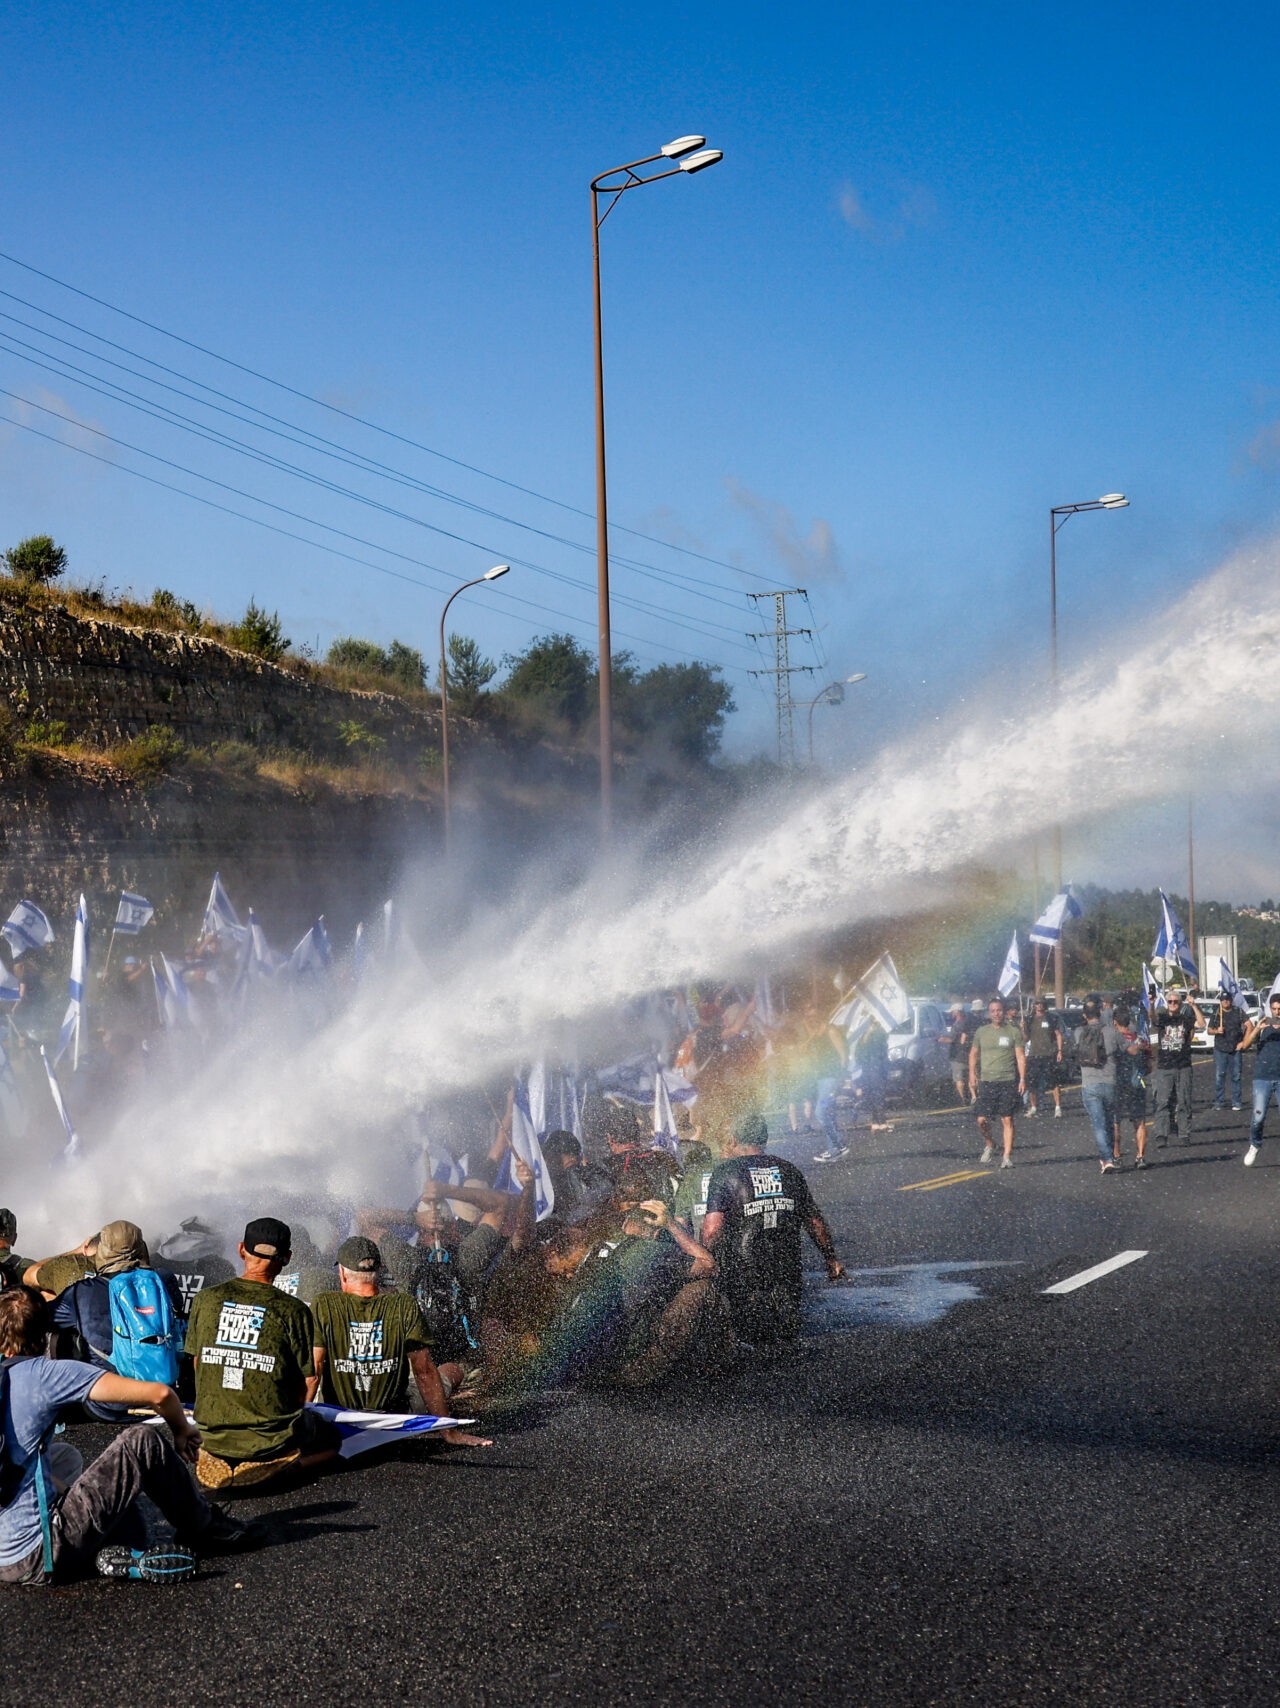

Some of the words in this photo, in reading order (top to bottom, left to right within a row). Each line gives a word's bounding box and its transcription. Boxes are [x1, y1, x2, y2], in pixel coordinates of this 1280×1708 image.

[218, 1312, 250, 1330] אחים
[216, 1325, 261, 1345] לנשק
[224, 1356, 241, 1367] את
